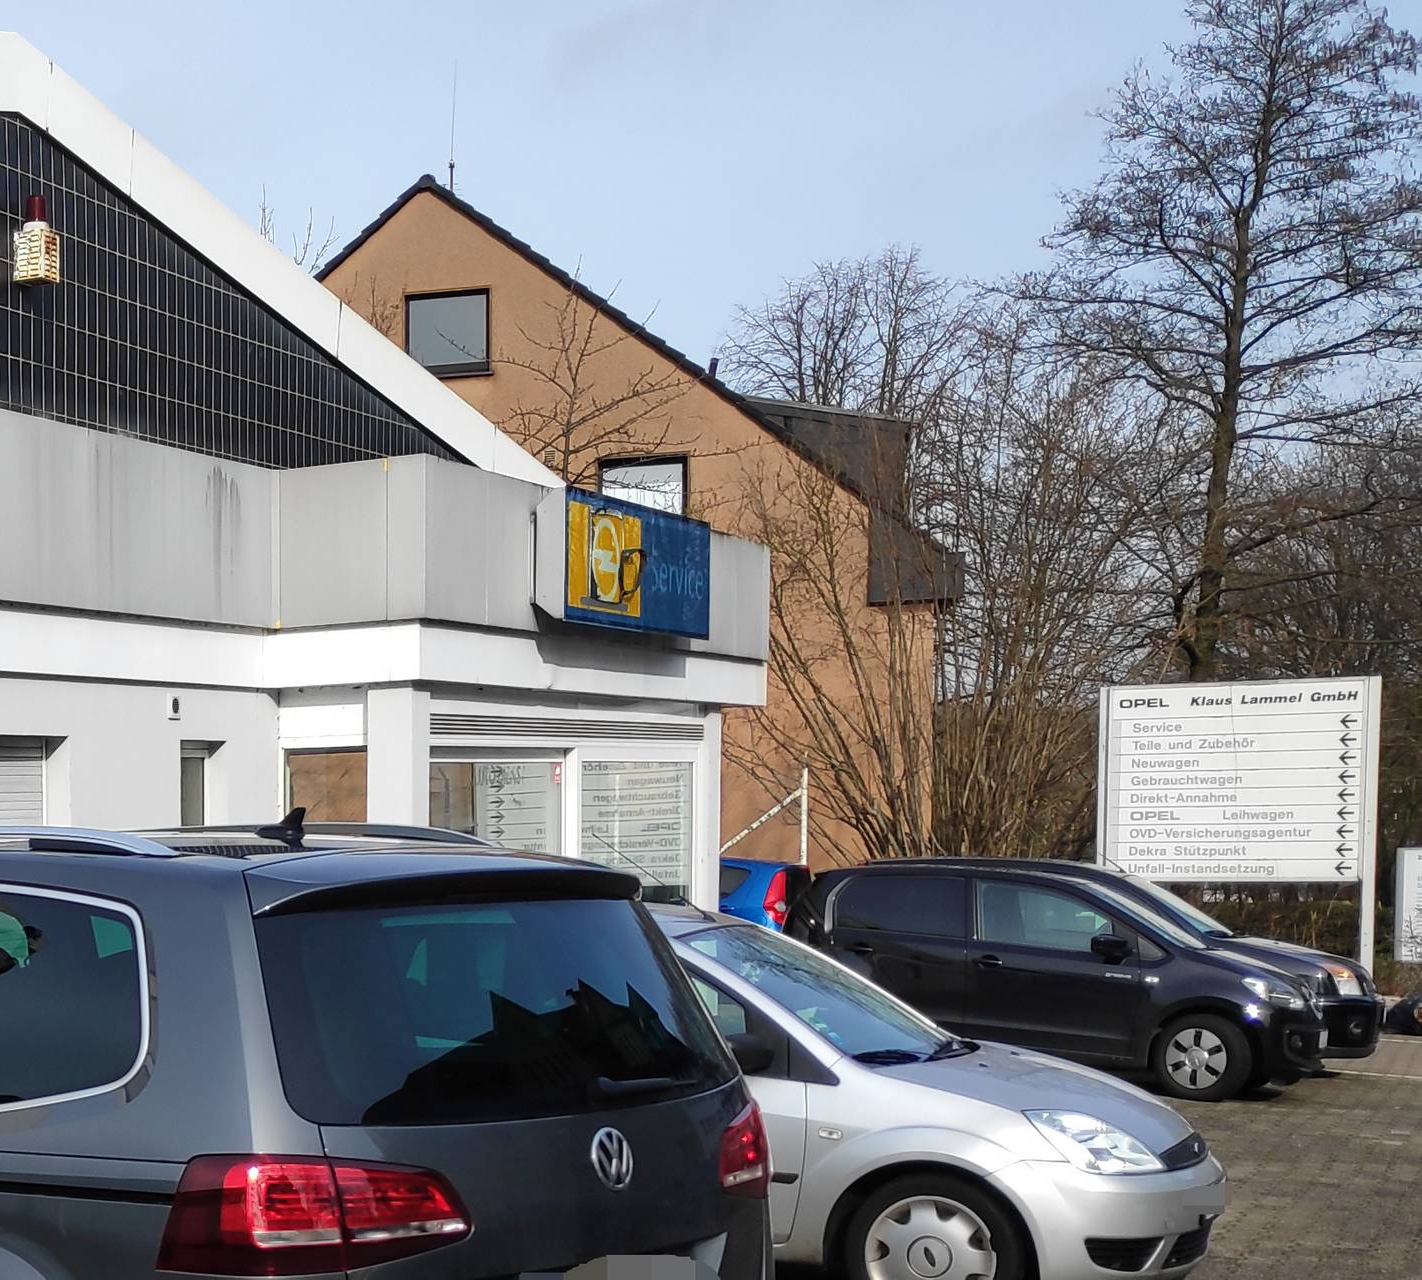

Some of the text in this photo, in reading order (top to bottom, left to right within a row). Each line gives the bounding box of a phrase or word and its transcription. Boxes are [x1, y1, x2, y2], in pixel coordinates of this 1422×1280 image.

[651, 561, 704, 600] Service
[1119, 690, 1359, 709] OPEL Klaus Lammel GmbH
[1132, 721, 1183, 733] Service
[1132, 737, 1255, 751] Teile und Zubehör
[1131, 757, 1200, 769] Neuwagen
[1130, 775, 1243, 786] Gebrauchtwagen
[1130, 792, 1238, 804] Direkt-Annahme
[1130, 809, 1294, 821] OPEL Leihwagen
[1129, 826, 1312, 841] OVD-Versicherungsagentur
[1128, 844, 1247, 858] Dekra Stützpunkt
[1128, 861, 1275, 876] Unfall-Instandsetzung
